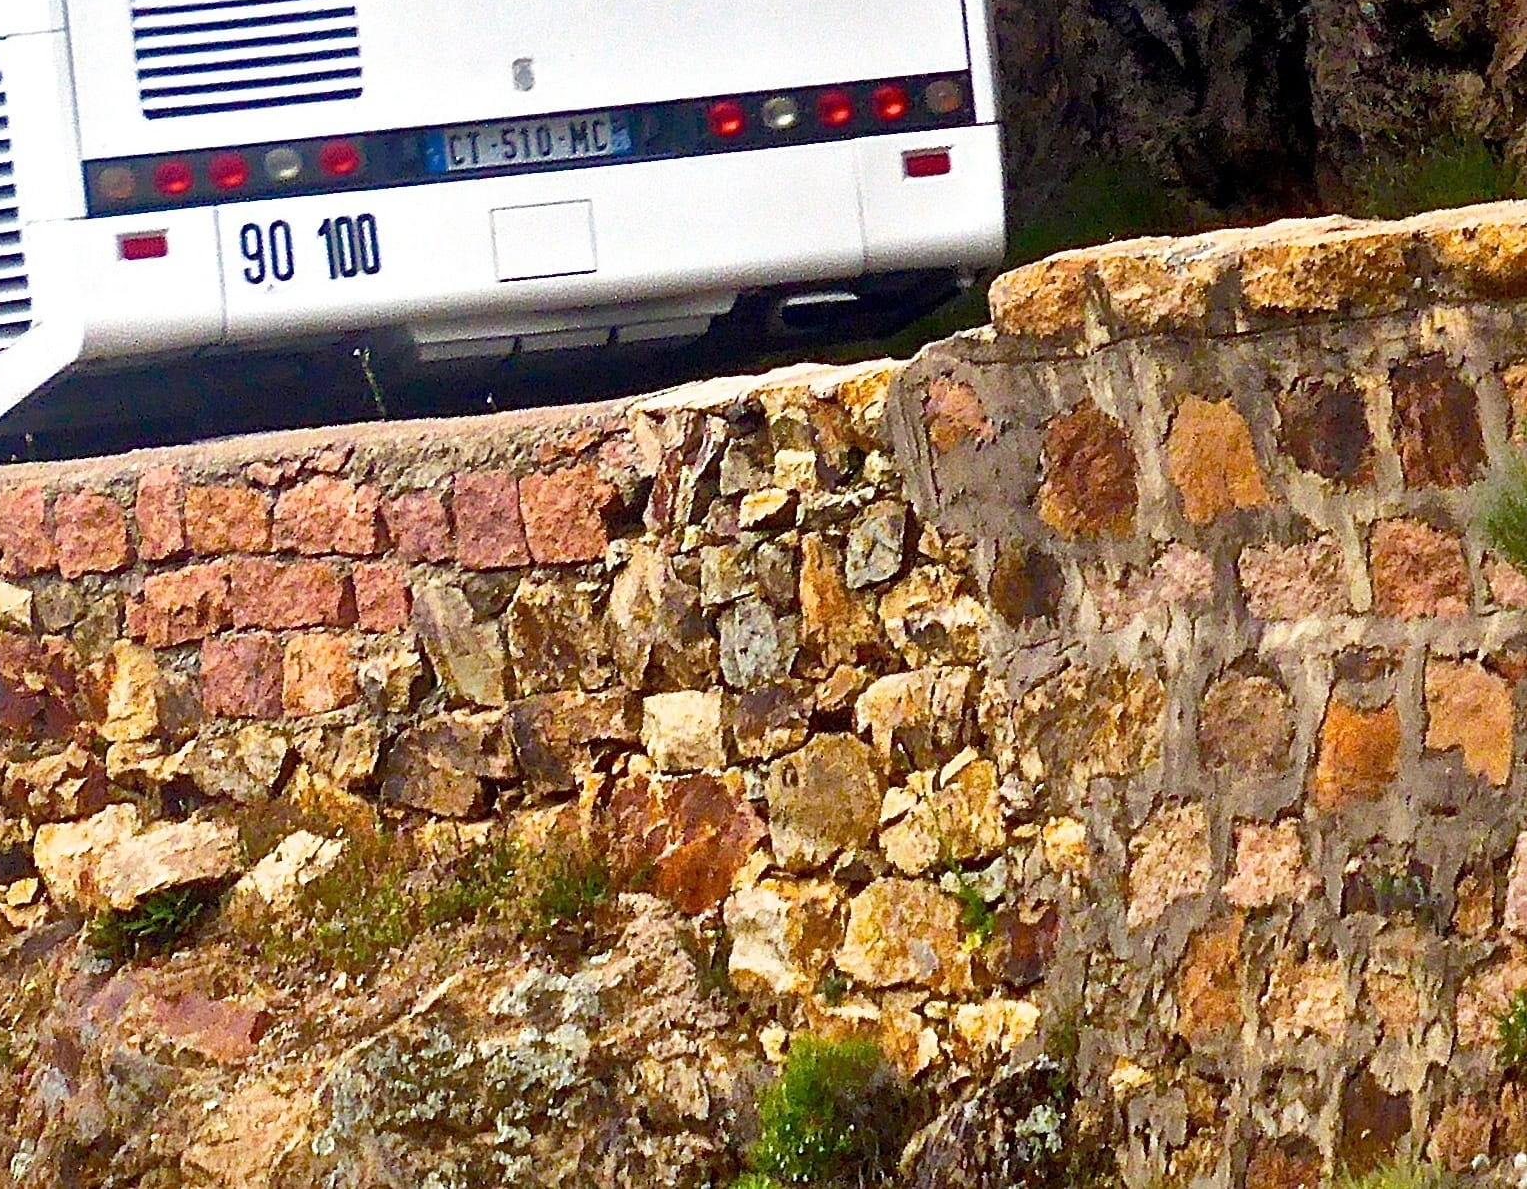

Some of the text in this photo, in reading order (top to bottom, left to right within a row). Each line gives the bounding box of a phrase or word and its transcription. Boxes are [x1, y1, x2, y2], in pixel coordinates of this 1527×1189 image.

[448, 120, 609, 166] CT-510-MC
[240, 213, 381, 285] 90 100
